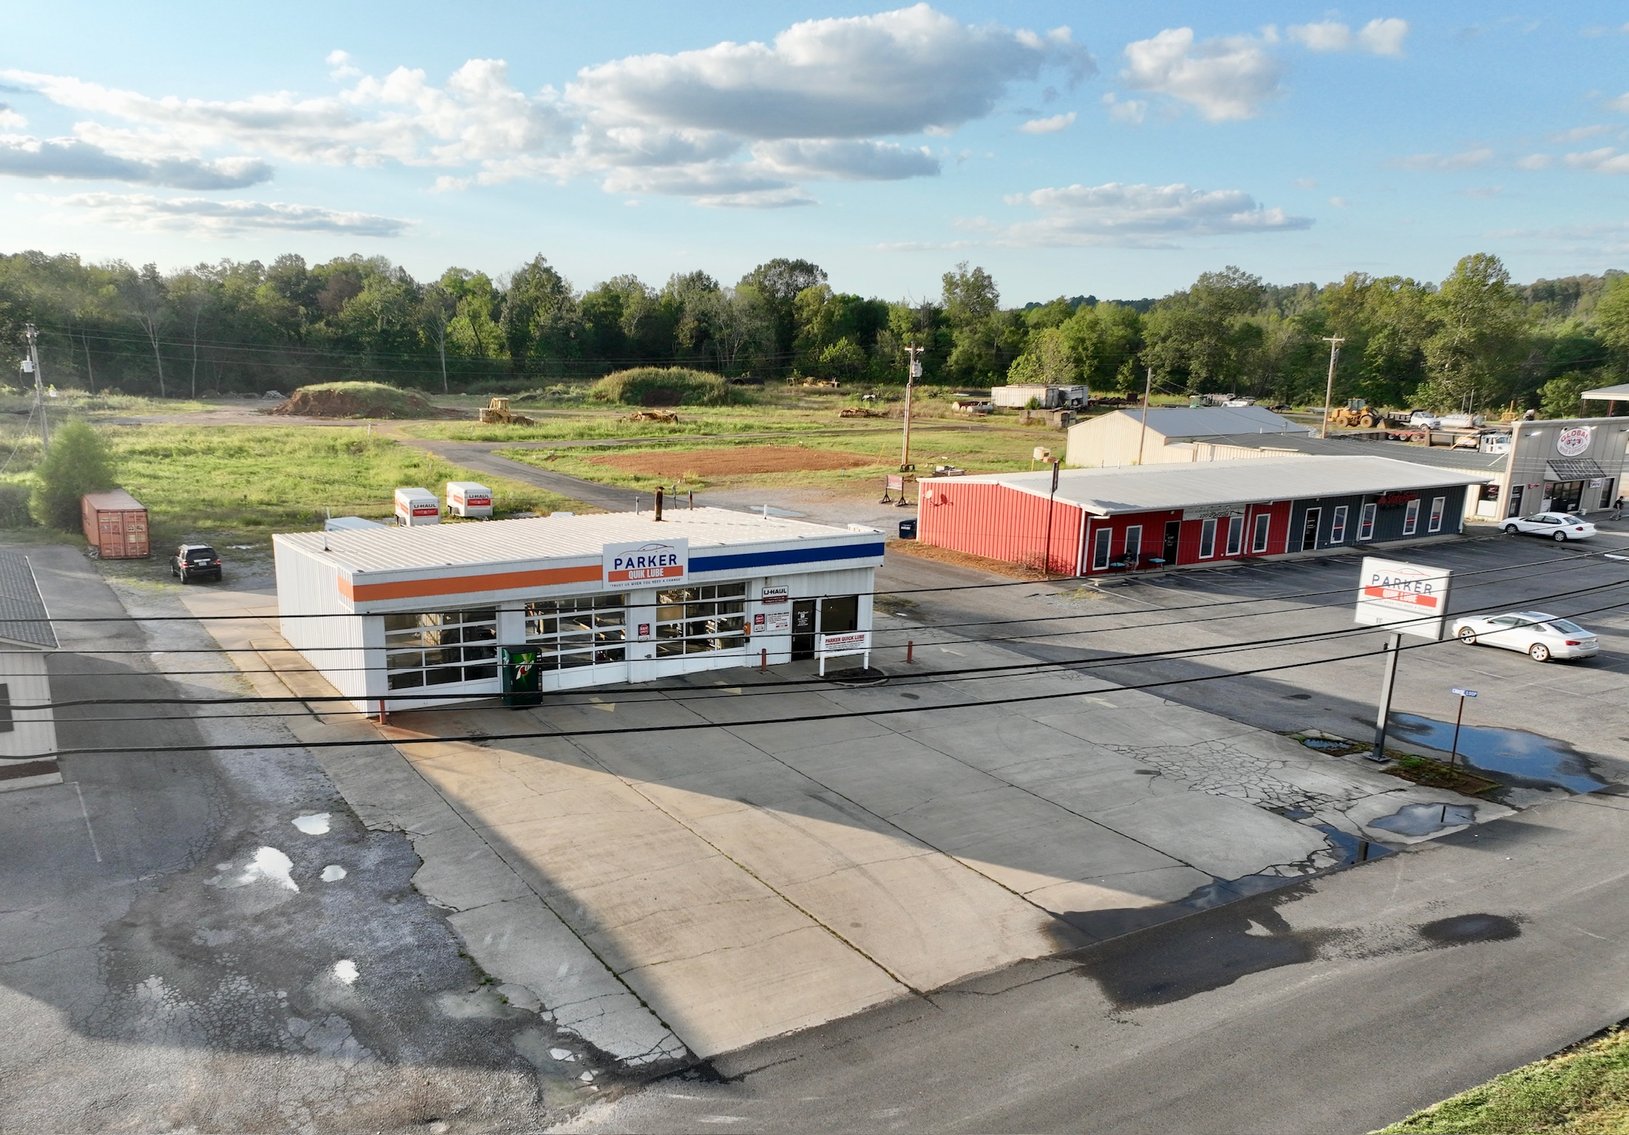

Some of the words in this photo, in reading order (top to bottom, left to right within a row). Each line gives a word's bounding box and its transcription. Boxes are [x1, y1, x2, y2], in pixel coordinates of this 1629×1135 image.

[1561, 430, 1588, 442] GLOBAL
[614, 553, 677, 570] PARKER
[628, 569, 645, 580] QUIK
[646, 567, 664, 578] LUBE
[1371, 574, 1433, 595] PARKER
